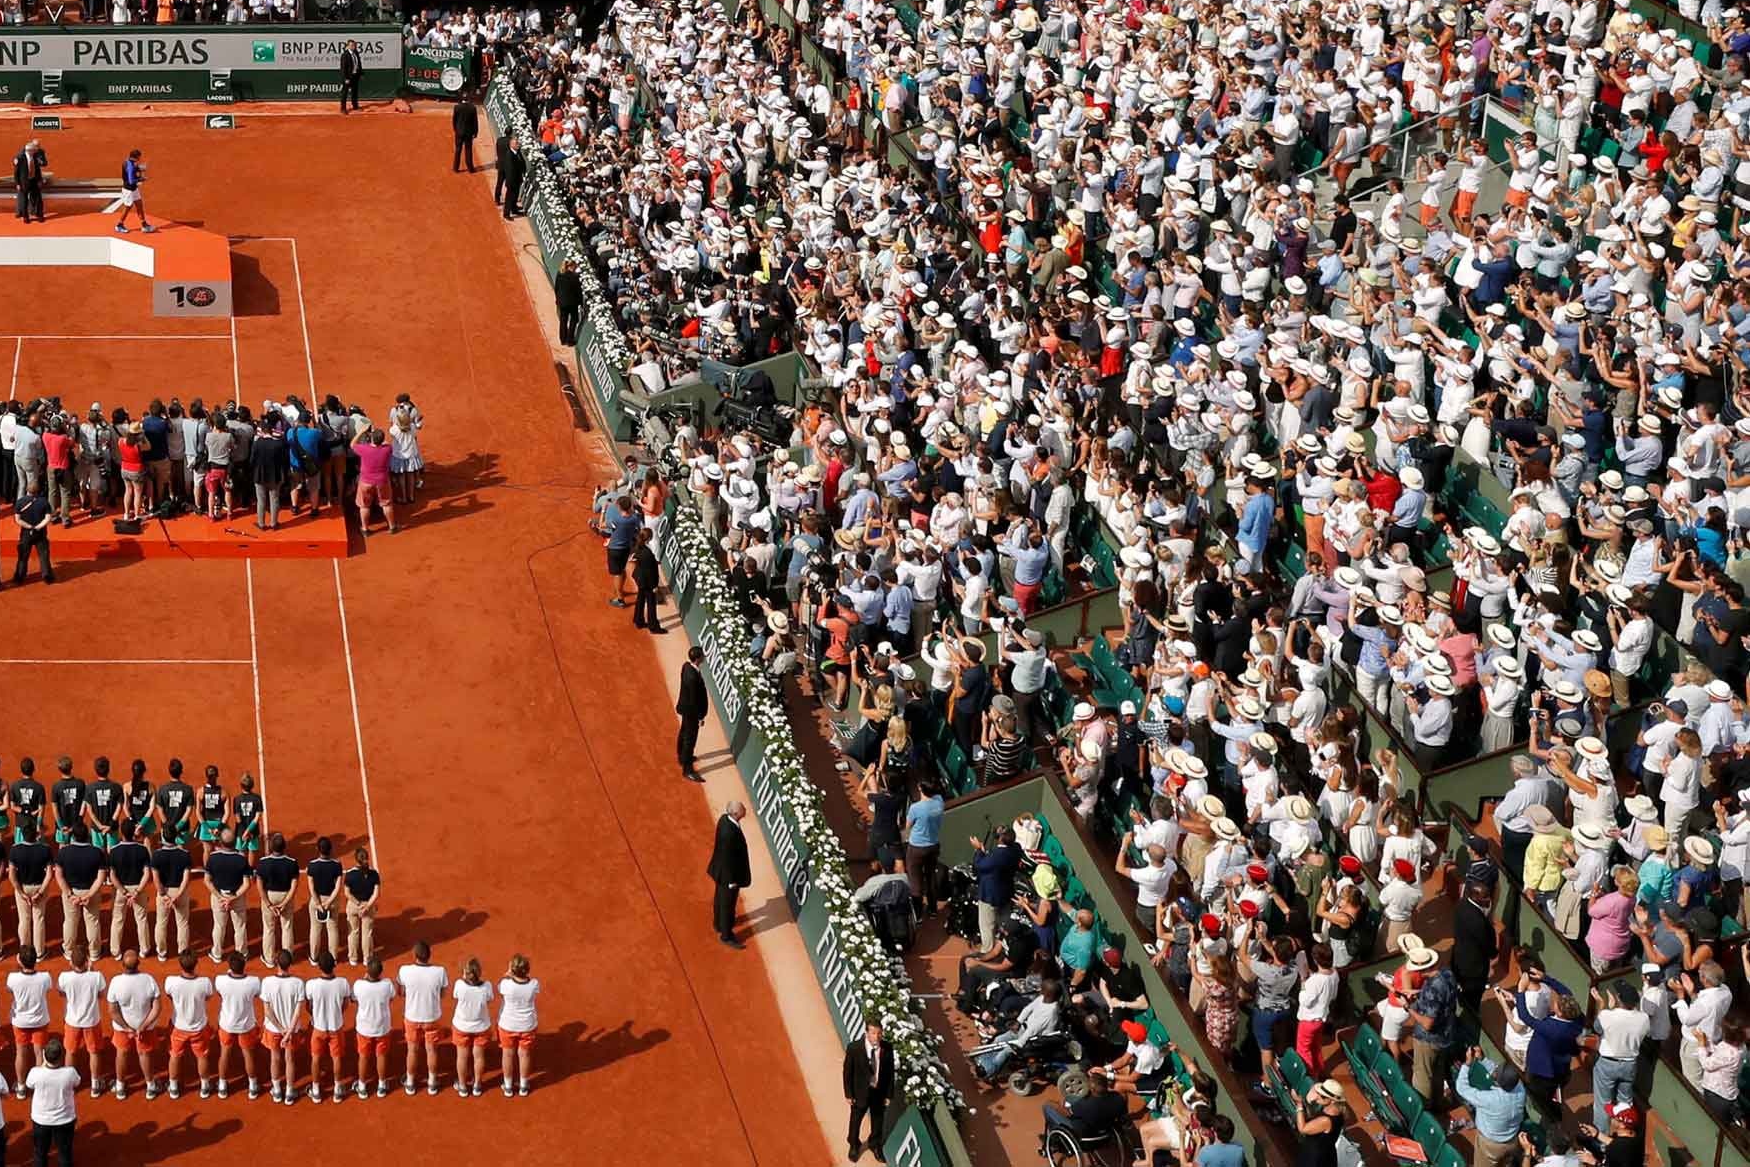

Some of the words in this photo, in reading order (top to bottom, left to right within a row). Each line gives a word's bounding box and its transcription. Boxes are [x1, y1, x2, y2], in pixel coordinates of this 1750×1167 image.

[73, 39, 210, 66] PARIBAS
[282, 41, 314, 54] BNP
[318, 41, 384, 54] PARBAS
[410, 47, 464, 60] LONGINES
[108, 84, 129, 94] BNP
[129, 84, 173, 94] PARIBAS
[286, 84, 308, 93] BNP
[34, 119, 59, 127] LACOSTE
[534, 201, 559, 258] PEUGEOT
[586, 335, 615, 403] LONGINES
[698, 619, 741, 723] LONGINES
[752, 756, 776, 816] Fly
[765, 789, 812, 906] Emirates
[816, 922, 842, 990] Fly
